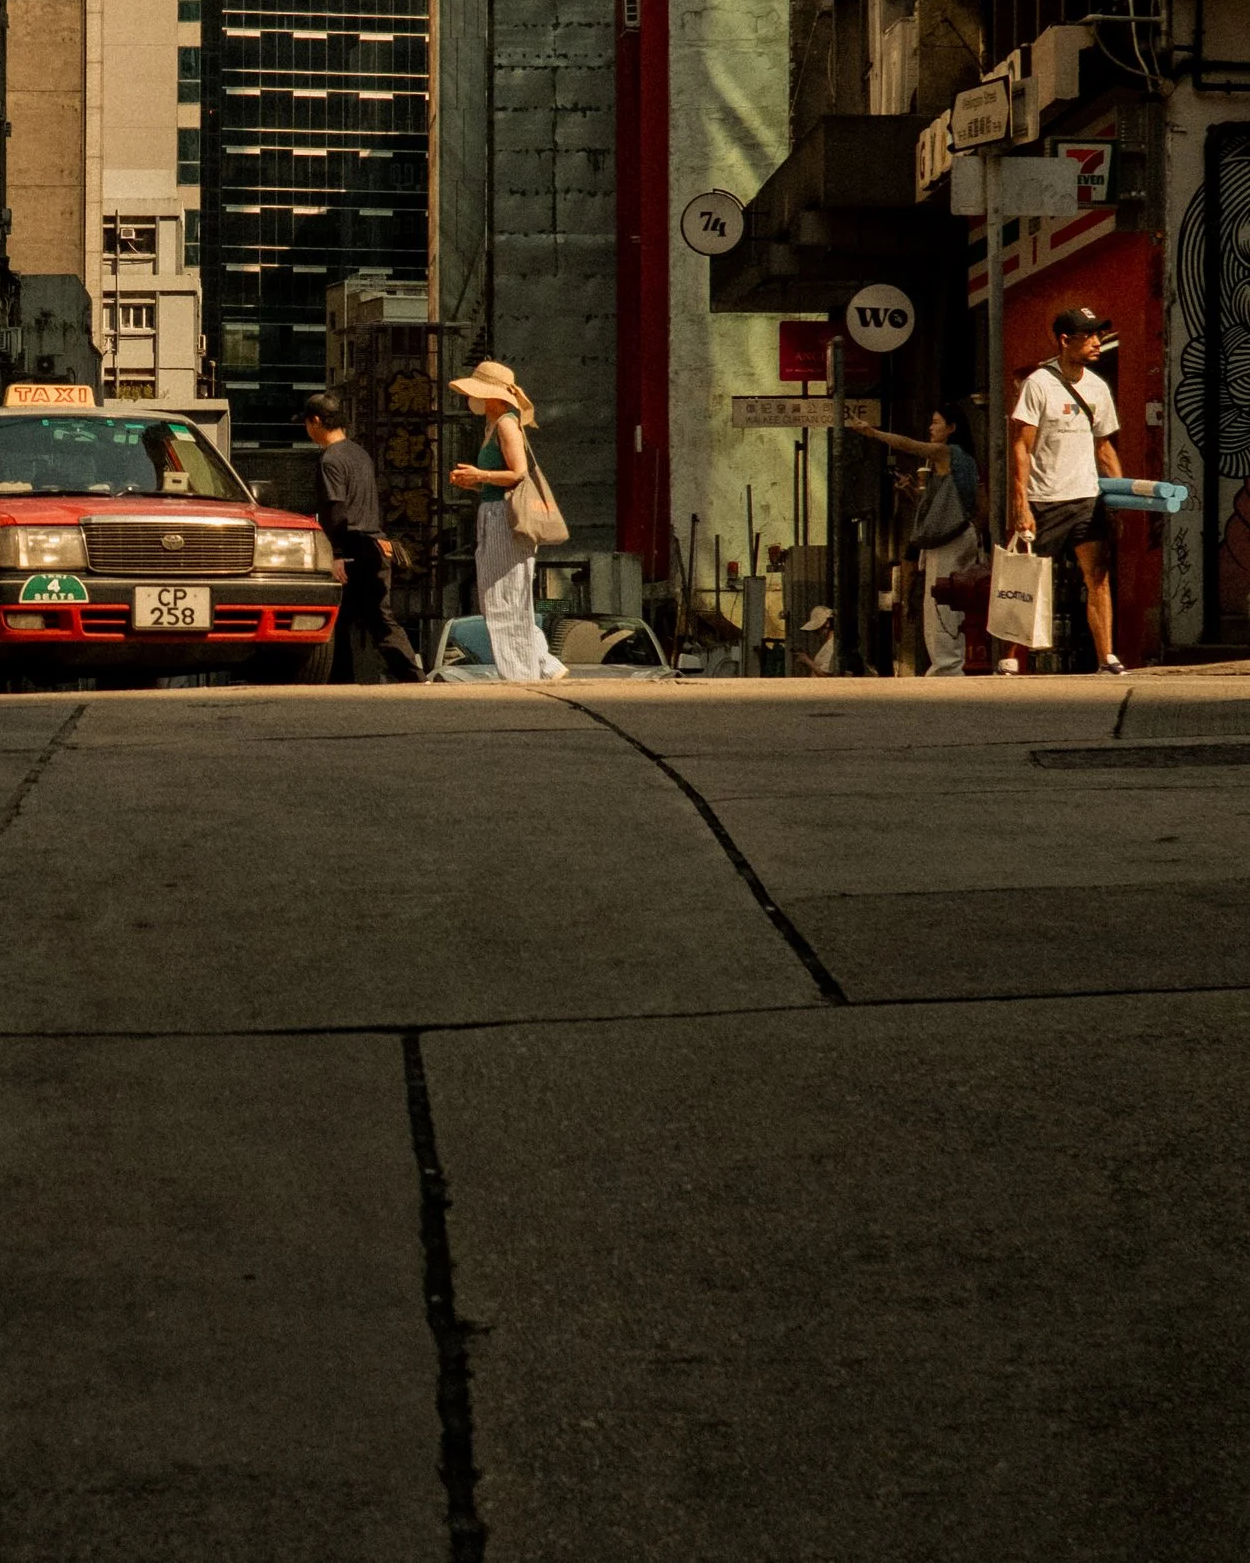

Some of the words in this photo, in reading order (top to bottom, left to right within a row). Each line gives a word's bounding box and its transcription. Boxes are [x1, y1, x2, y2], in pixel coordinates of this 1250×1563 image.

[700, 211, 727, 237] 74
[14, 387, 87, 403] TAXI
[47, 578, 61, 592] 4
[34, 592, 75, 601] SEATS
[157, 588, 187, 607] CP
[150, 606, 195, 626] 258
